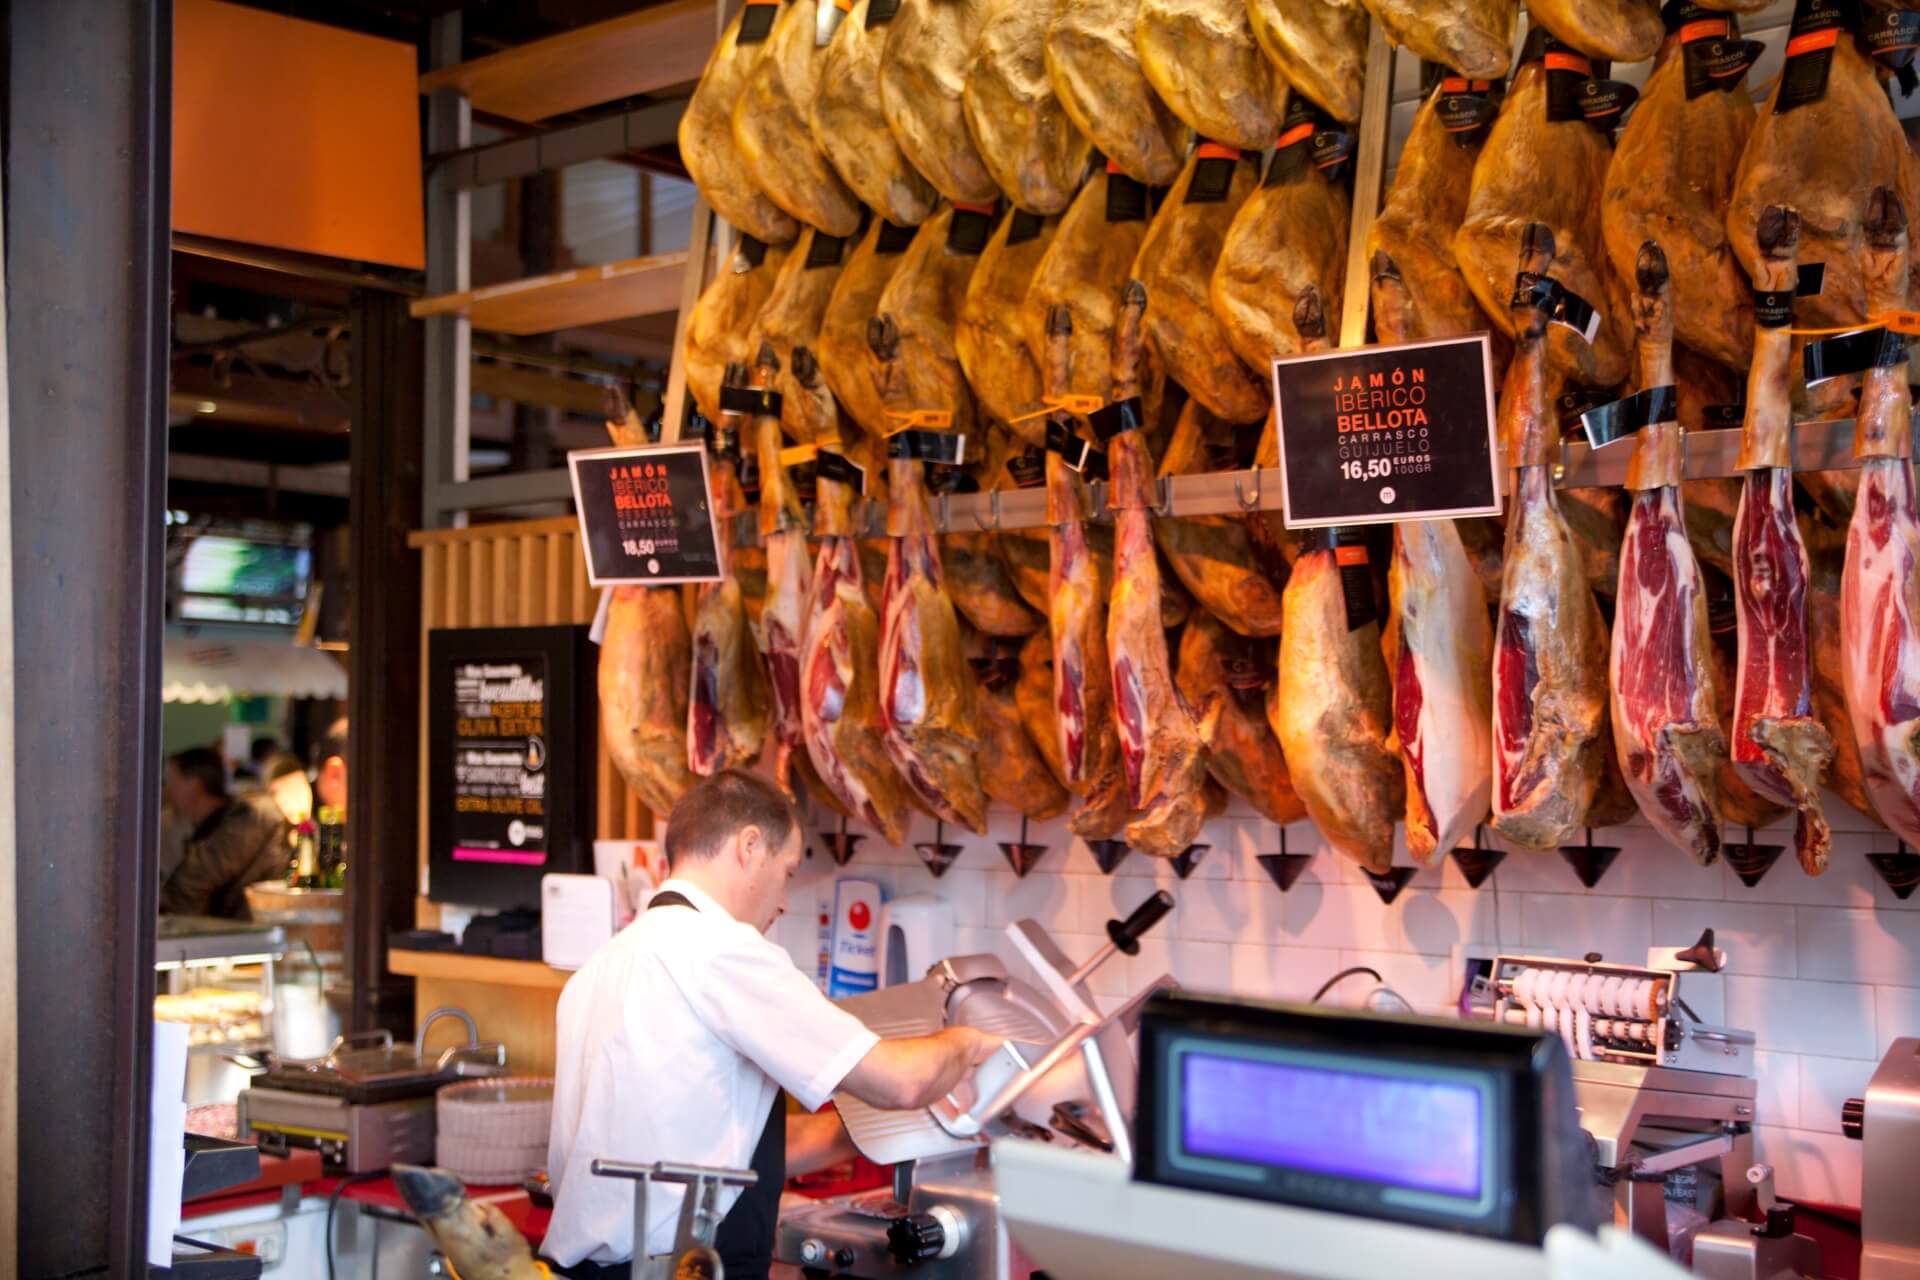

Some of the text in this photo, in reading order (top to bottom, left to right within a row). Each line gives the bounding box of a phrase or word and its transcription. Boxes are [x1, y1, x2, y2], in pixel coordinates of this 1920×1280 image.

[1333, 368, 1425, 391] JAMÓN
[1335, 386, 1426, 412] IBÉRICO
[1337, 408, 1428, 433] BELLOTA
[1338, 427, 1429, 445] CARRASCO
[1339, 439, 1430, 460] GUIJUELO
[610, 463, 668, 480] JAMÓN
[1340, 454, 1431, 482] 16,50 EUROS
[1394, 463, 1432, 475] 100GR
[614, 493, 673, 510] BELLOTA
[622, 538, 655, 557] 18,50
